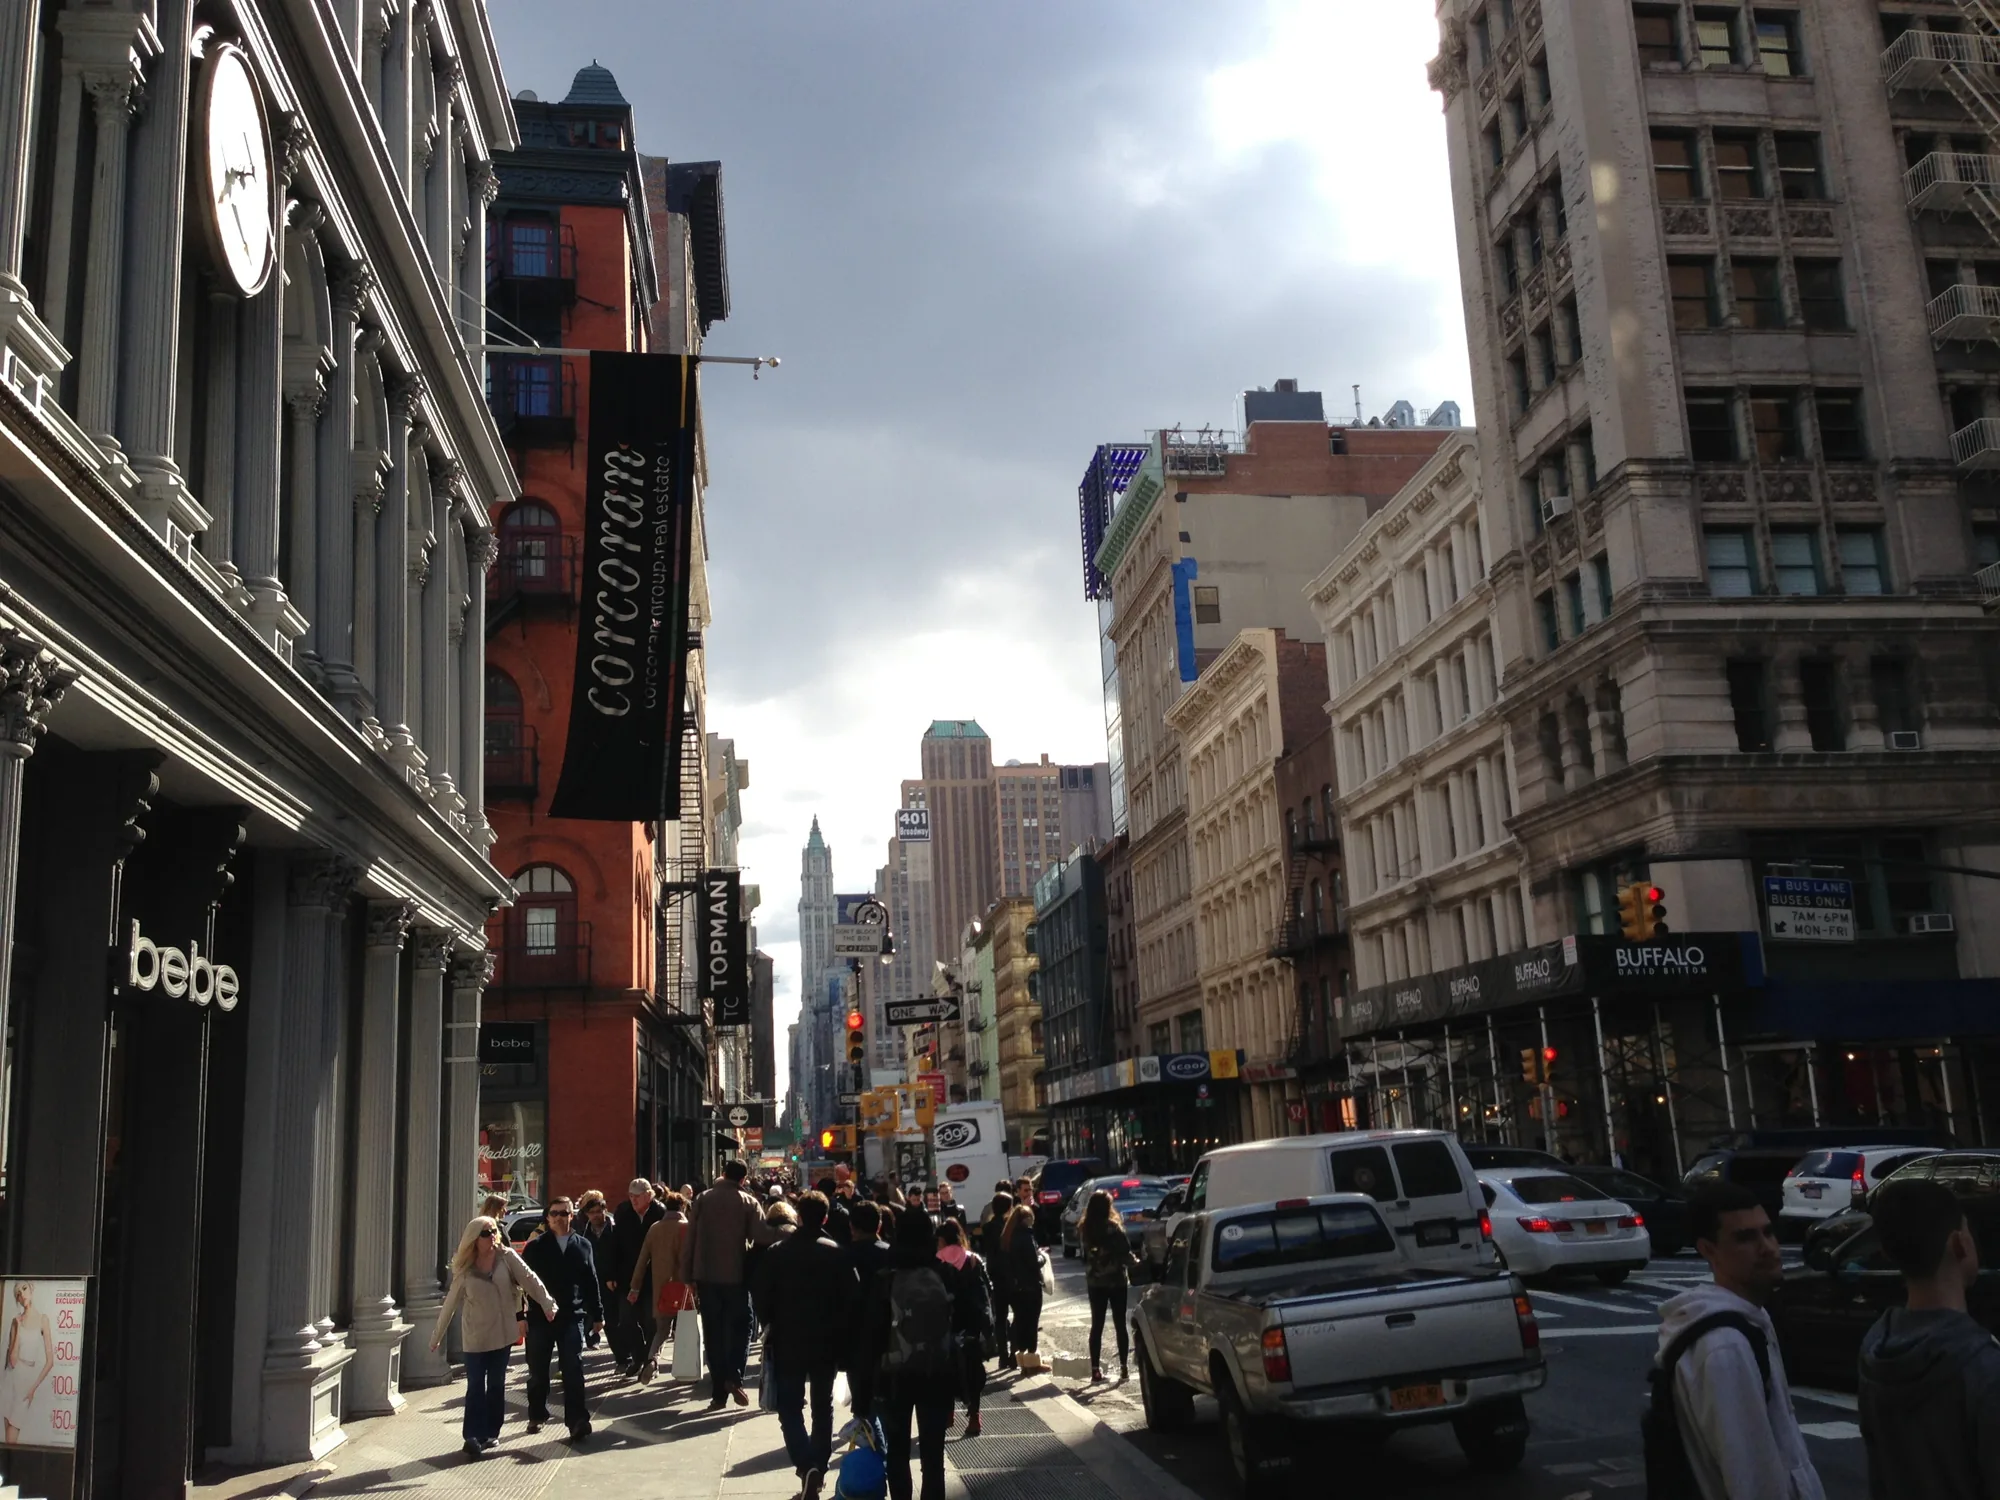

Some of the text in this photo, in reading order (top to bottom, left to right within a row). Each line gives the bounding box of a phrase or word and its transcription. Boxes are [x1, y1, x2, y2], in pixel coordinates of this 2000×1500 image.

[652, 456, 670, 515] estate
[588, 449, 646, 716] corcoran
[900, 812, 927, 825] 401
[900, 827, 929, 837] Broadway
[1785, 880, 1846, 893] BUS LANE
[1771, 893, 1846, 907] BUSES ONLY
[709, 880, 729, 992] TOPMAN
[1794, 923, 1848, 936] MON-FRI
[129, 918, 239, 1011] bebe
[1616, 946, 1705, 967] BUFFALO
[1515, 959, 1550, 982] BUFFALO
[1618, 966, 1708, 976] DAVID BITTON
[1450, 975, 1480, 996] BUFFALO
[891, 1003, 951, 1019] ONE WAY
[490, 1038, 531, 1048] bebe
[478, 1143, 541, 1163] Madewell
